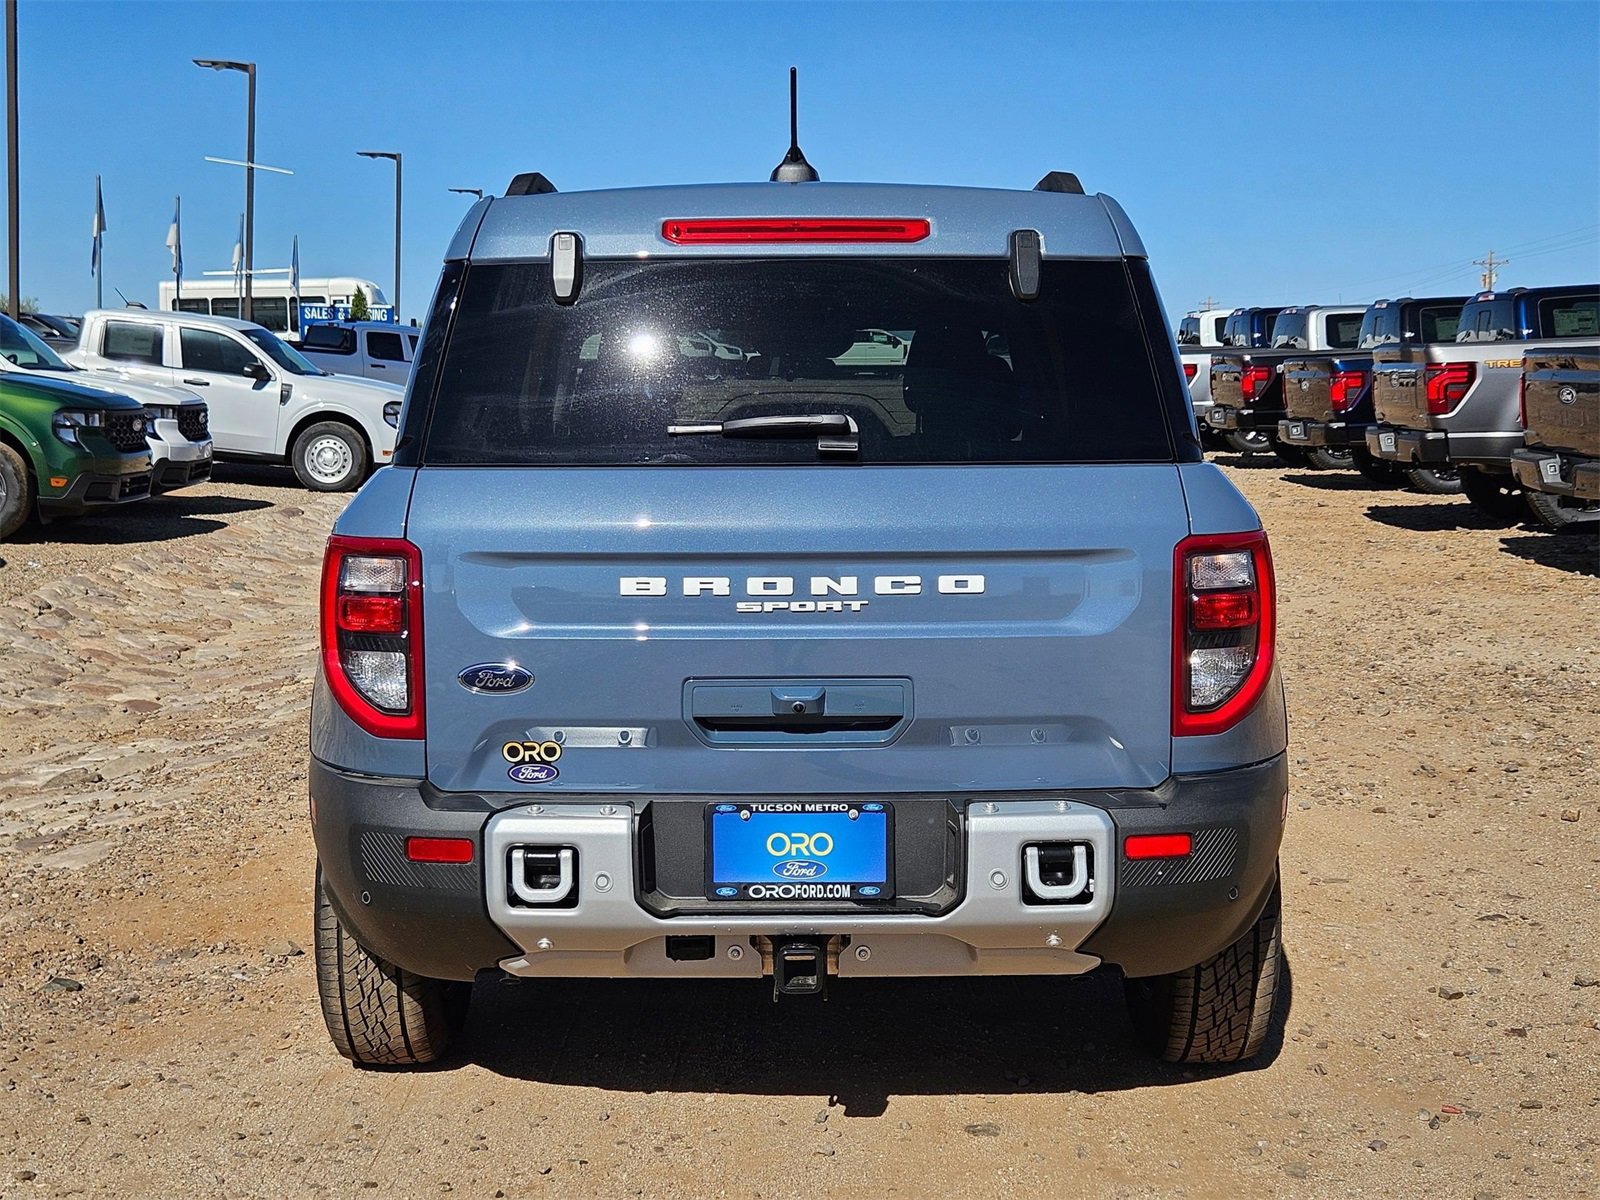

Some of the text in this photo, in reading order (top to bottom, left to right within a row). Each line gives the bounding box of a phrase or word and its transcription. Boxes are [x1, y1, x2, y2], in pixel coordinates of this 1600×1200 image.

[304, 307, 334, 319] SALES
[338, 307, 345, 319] &
[619, 574, 985, 597] BRONCO
[736, 600, 869, 612] SPORT
[475, 669, 515, 687] Ford
[502, 740, 562, 763] ORO
[518, 765, 548, 779] Ford
[750, 803, 849, 812] TUCSON METRO
[766, 832, 834, 857] ORO
[782, 862, 817, 877] Ford
[748, 884, 850, 899] OROFORD.COM
